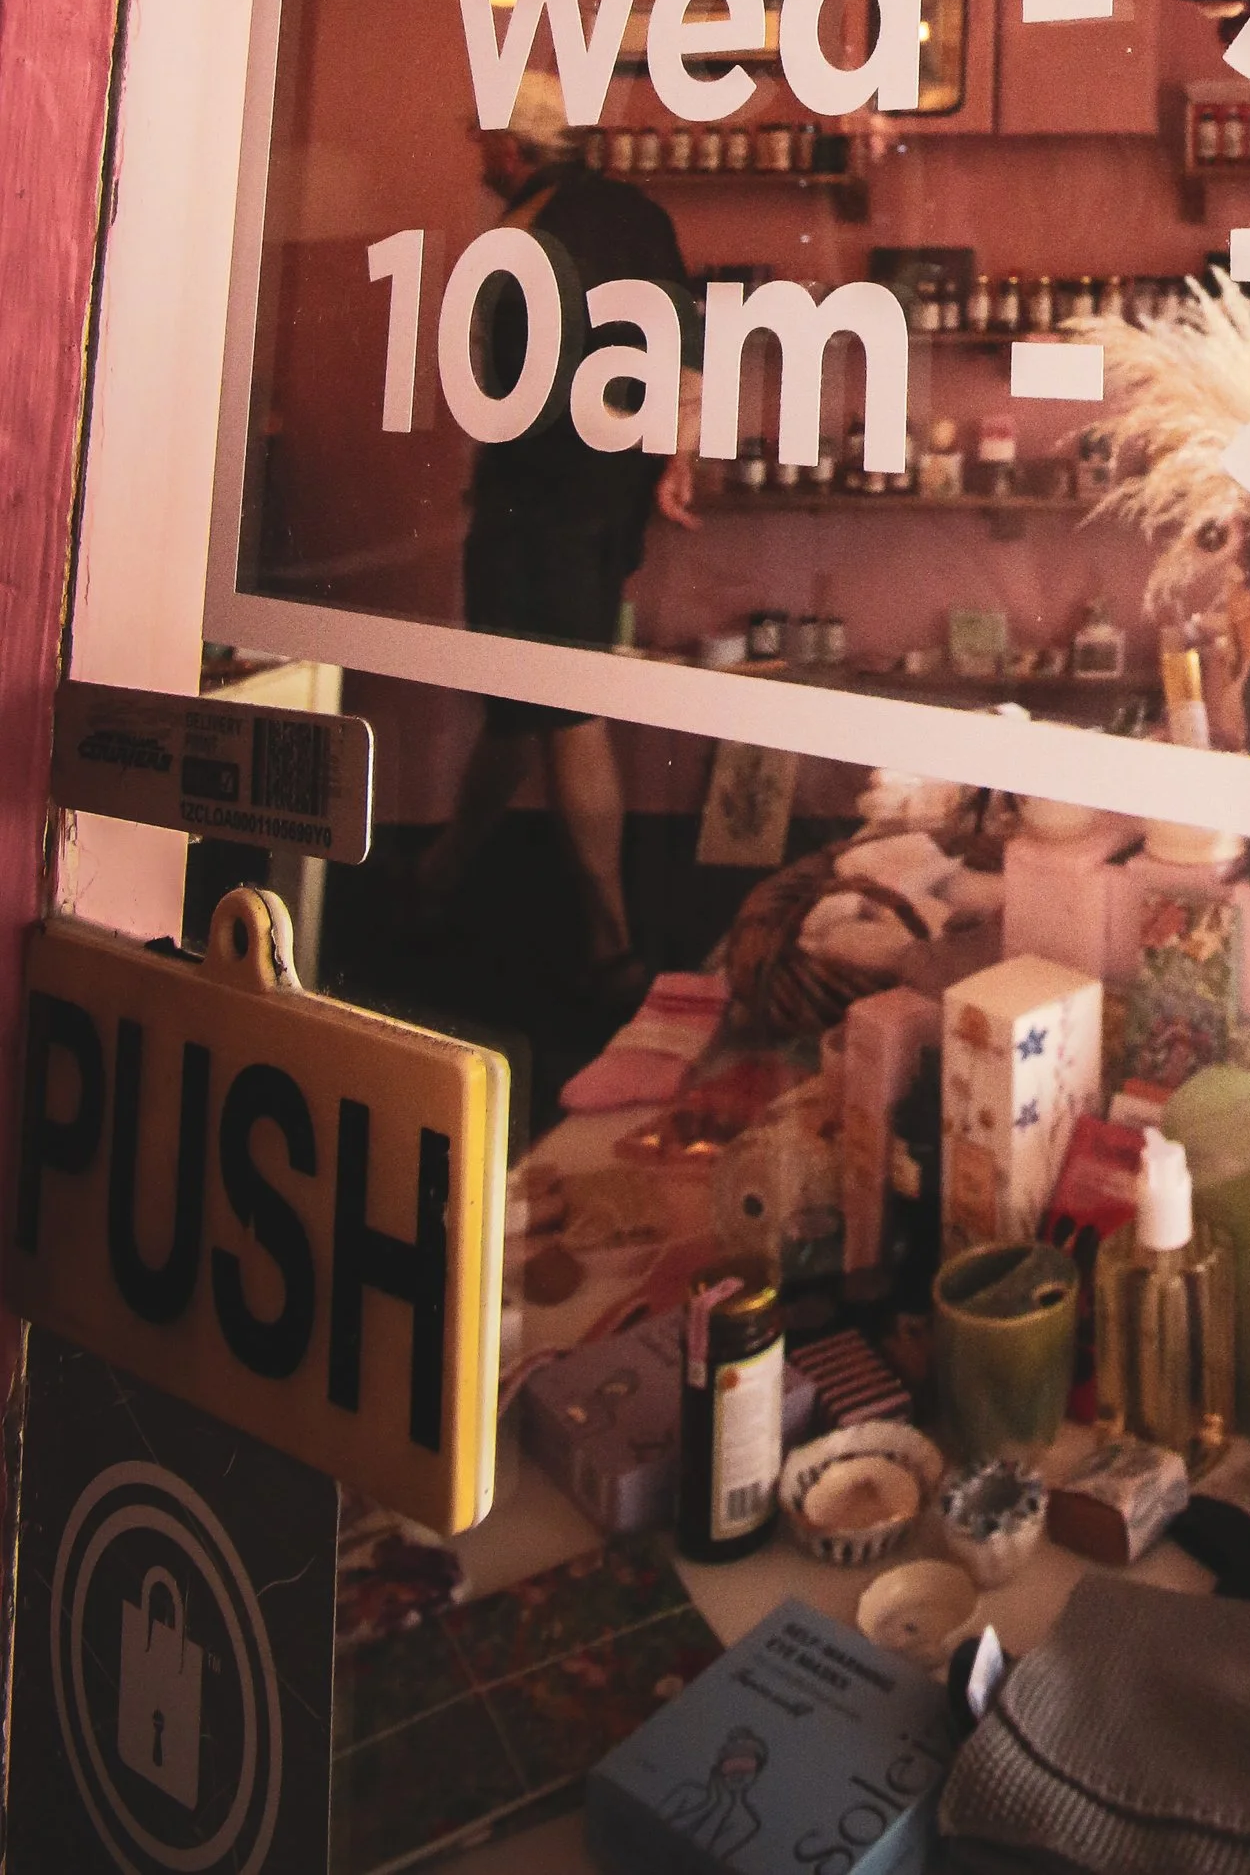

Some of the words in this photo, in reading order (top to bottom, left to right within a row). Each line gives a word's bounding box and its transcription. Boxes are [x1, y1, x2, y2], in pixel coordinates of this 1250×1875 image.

[367, 227, 908, 473] 10am
[1011, 342, 1104, 400] -
[15, 989, 450, 1453] PUSH
